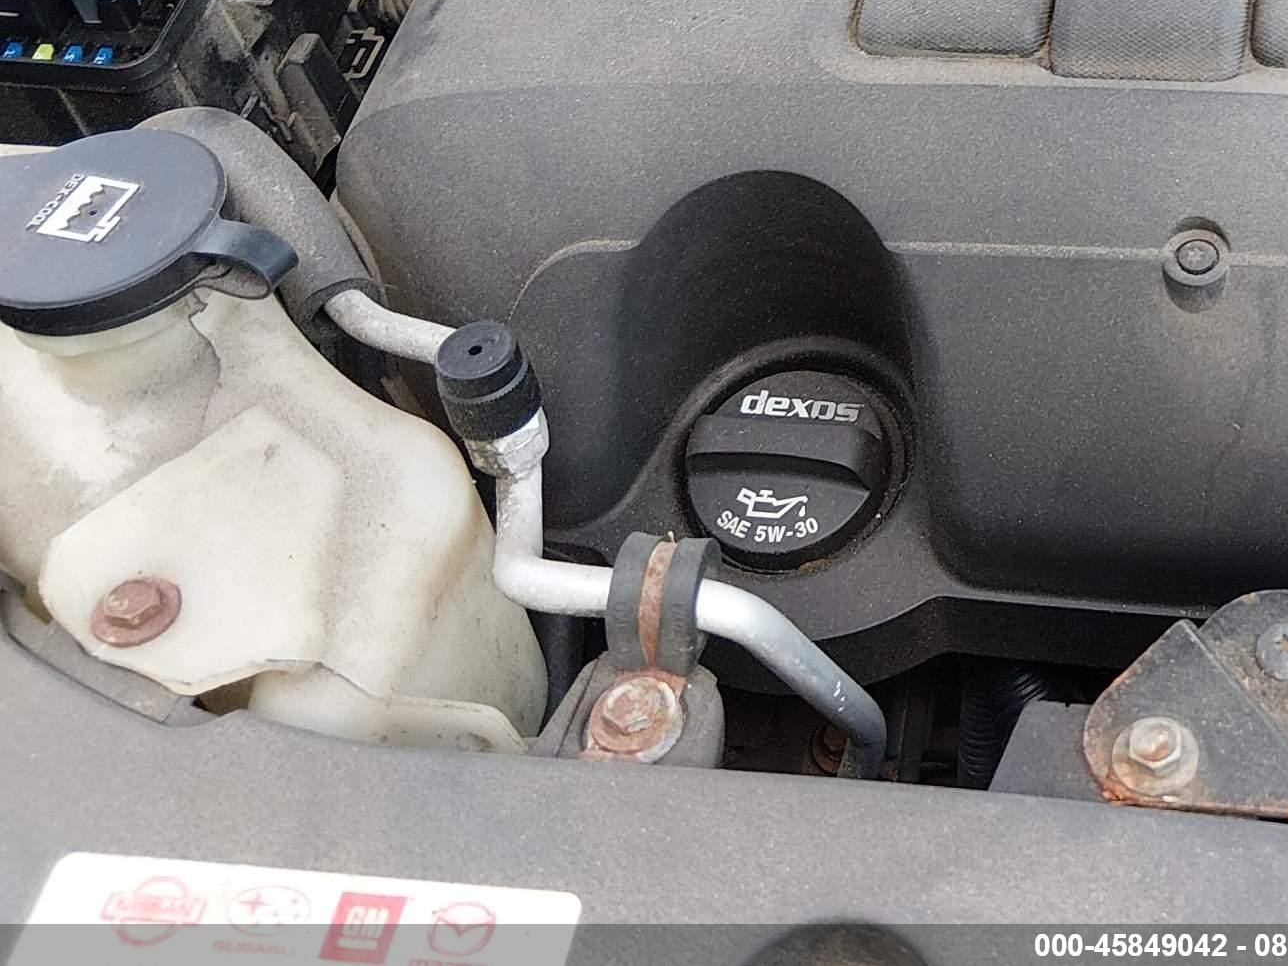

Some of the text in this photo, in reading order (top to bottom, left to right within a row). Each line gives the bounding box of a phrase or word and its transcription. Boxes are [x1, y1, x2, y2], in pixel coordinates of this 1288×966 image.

[740, 389, 862, 423] dexos
[716, 510, 819, 543] SAE 5W-30
[342, 906, 392, 936] GM
